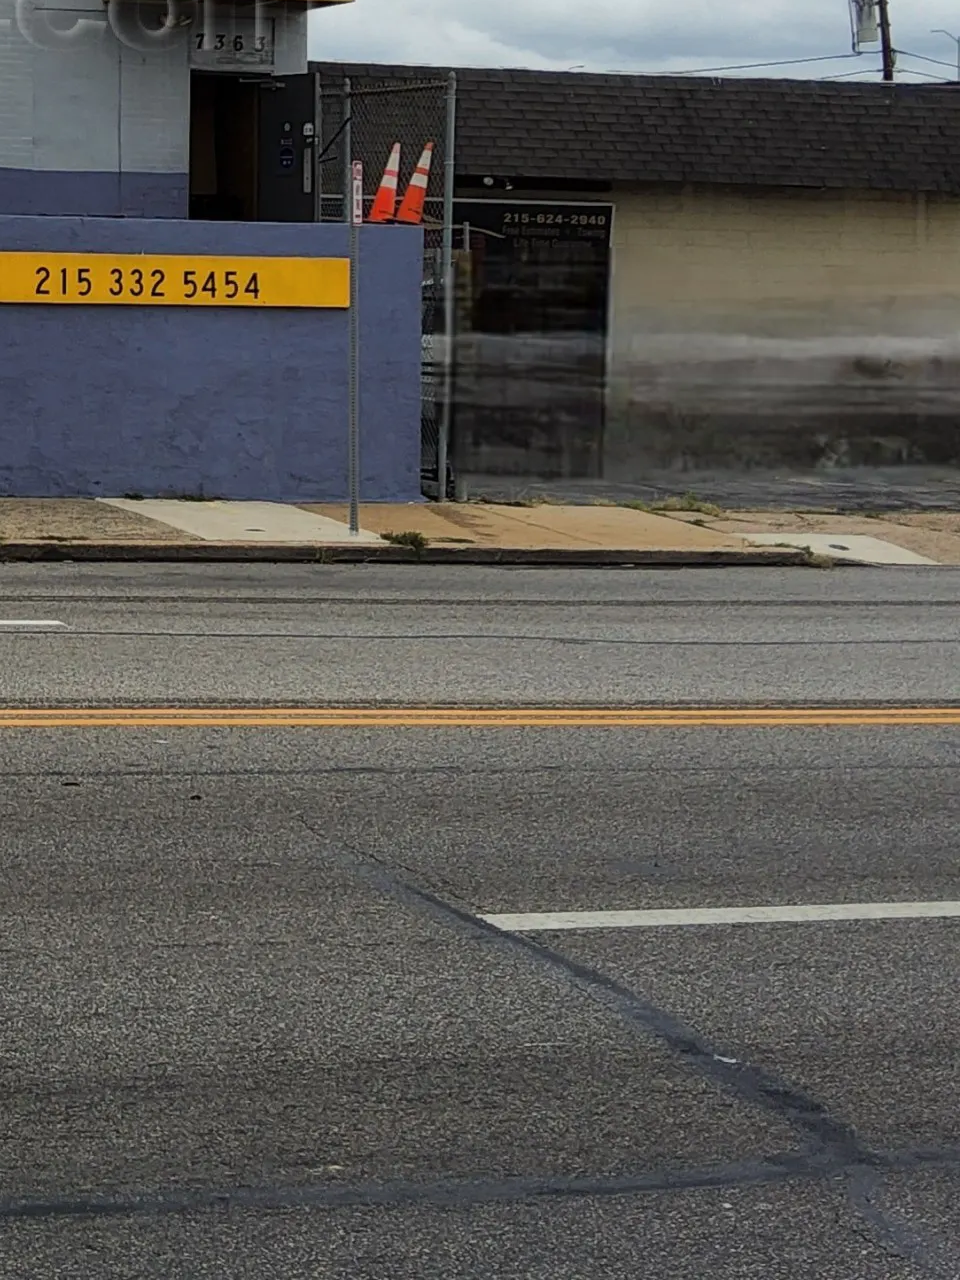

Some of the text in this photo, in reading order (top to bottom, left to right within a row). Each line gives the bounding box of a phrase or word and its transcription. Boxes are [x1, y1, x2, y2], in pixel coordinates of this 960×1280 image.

[195, 32, 267, 52] 7363
[503, 212, 607, 226] 215-624-2940
[35, 267, 260, 299] 215 332 5454
